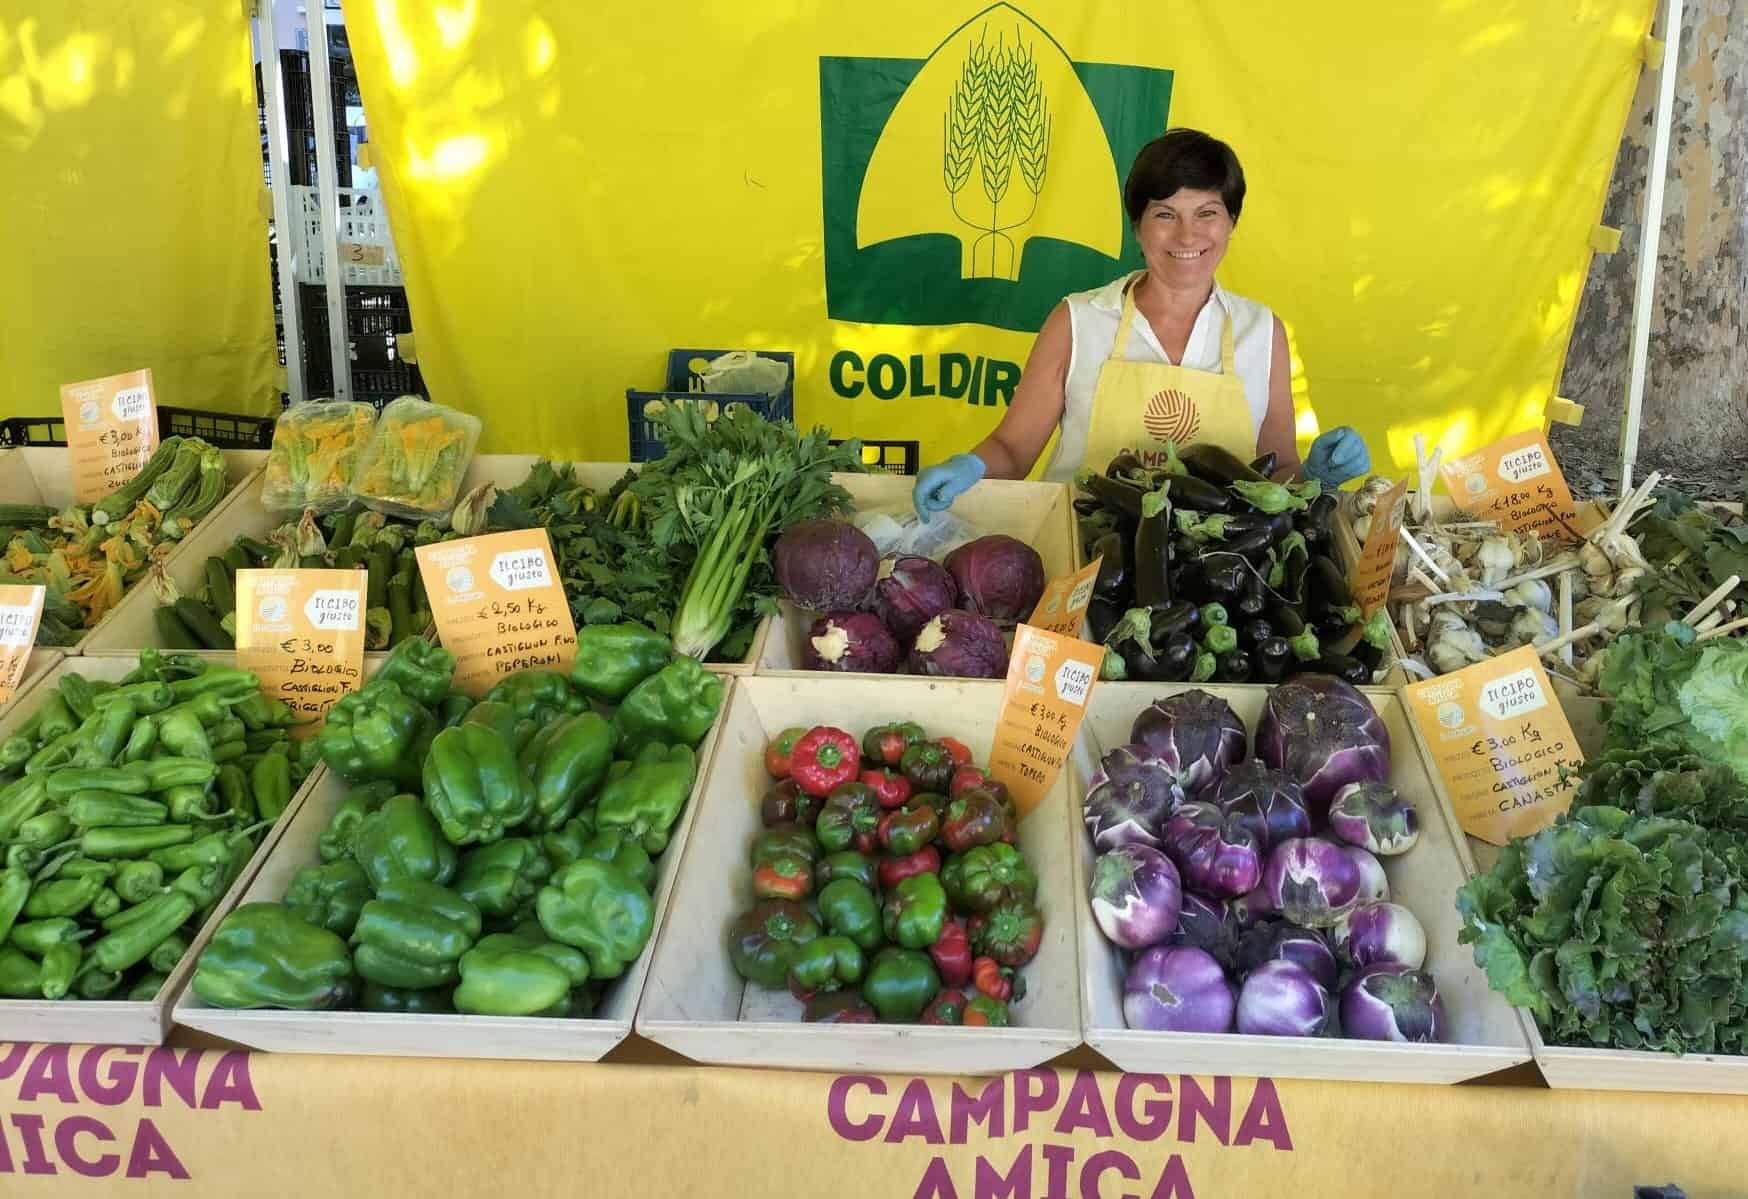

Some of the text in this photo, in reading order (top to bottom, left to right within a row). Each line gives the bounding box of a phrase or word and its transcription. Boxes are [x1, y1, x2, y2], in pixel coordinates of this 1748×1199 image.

[351, 243, 364, 262] 3
[829, 350, 1022, 407] COLDIR
[507, 569, 543, 587] giusto
[318, 611, 353, 625] giusto
[490, 601, 521, 617] 2,50
[303, 639, 334, 655] 3,00
[495, 652, 561, 674] PEPERONI
[1497, 692, 1536, 715] giusto
[1470, 740, 1486, 756] €
[1520, 721, 1542, 743] Kg
[1489, 741, 1564, 772] BIOLOGICO
[1498, 781, 1574, 812] CANASTA
[827, 1067, 1294, 1151] CAMPAGNA
[0, 1113, 193, 1180] ICA
[912, 1143, 1197, 1199] AMICA
